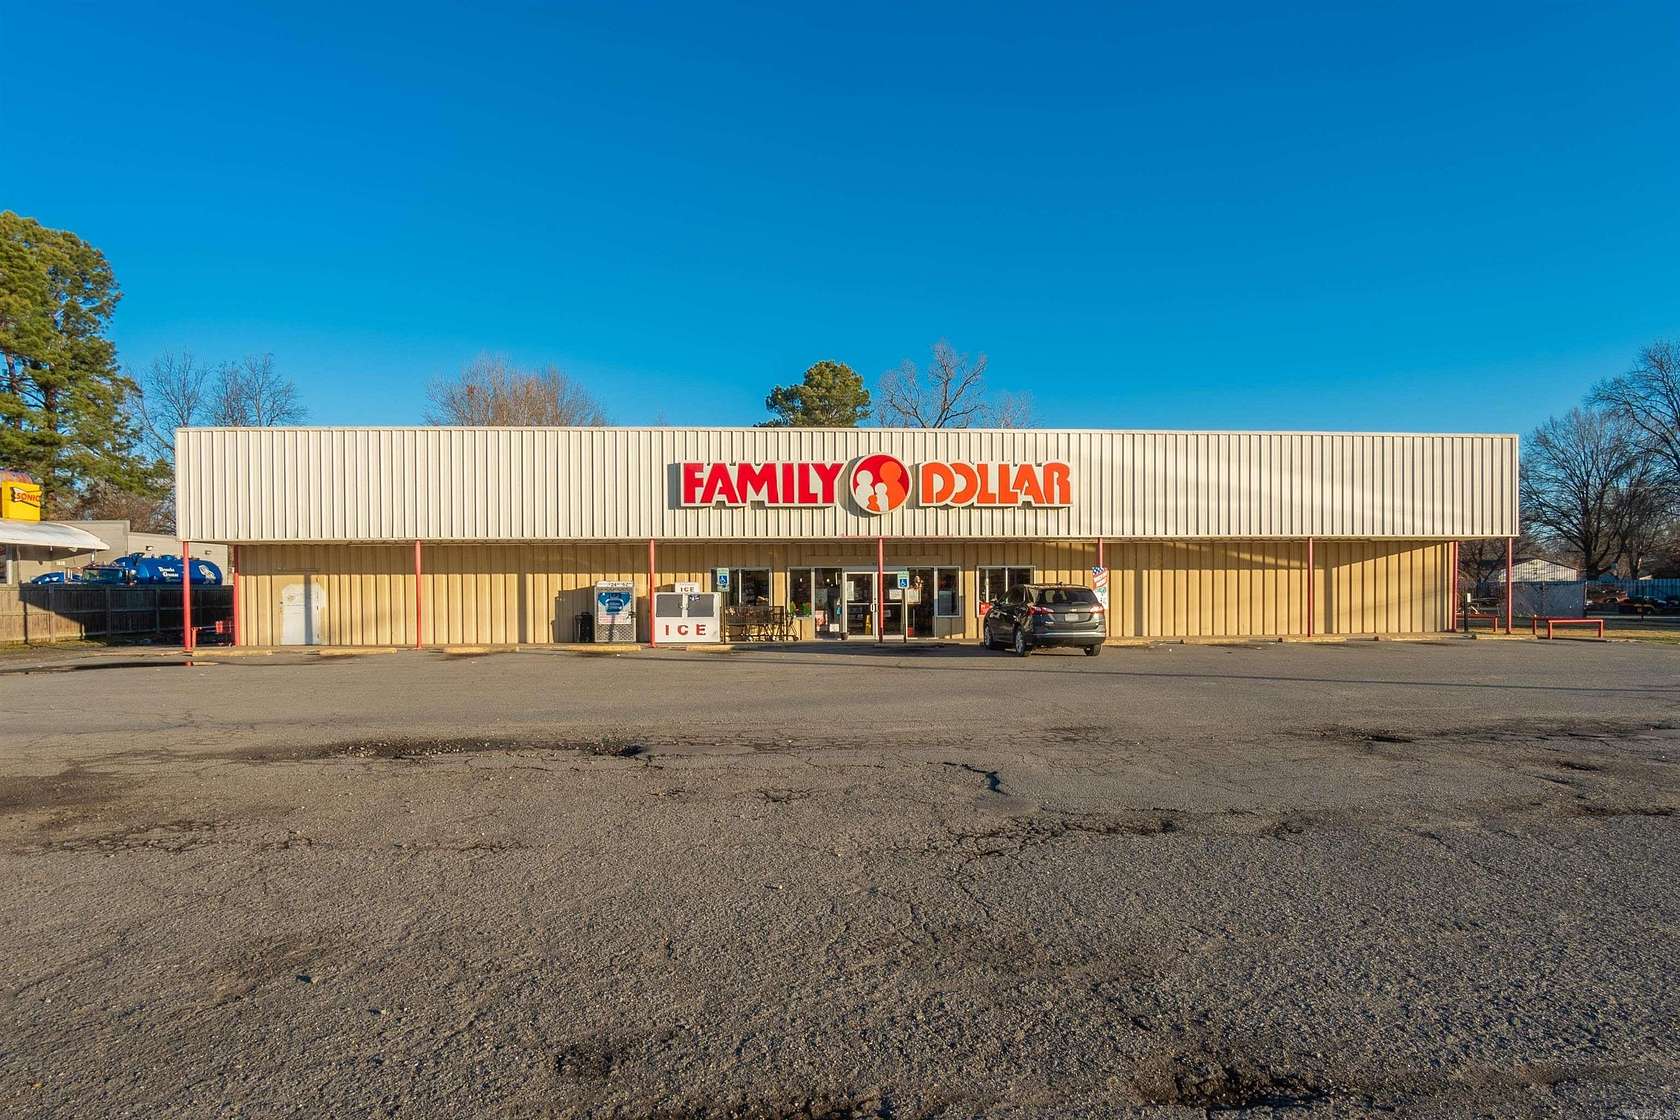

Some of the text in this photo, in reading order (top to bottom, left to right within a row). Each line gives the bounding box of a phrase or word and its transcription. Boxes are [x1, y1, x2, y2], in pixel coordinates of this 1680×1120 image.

[683, 461, 1072, 507] FAMILY DOLLAR
[16, 493, 40, 502] SONIC
[665, 624, 706, 636] ICE
